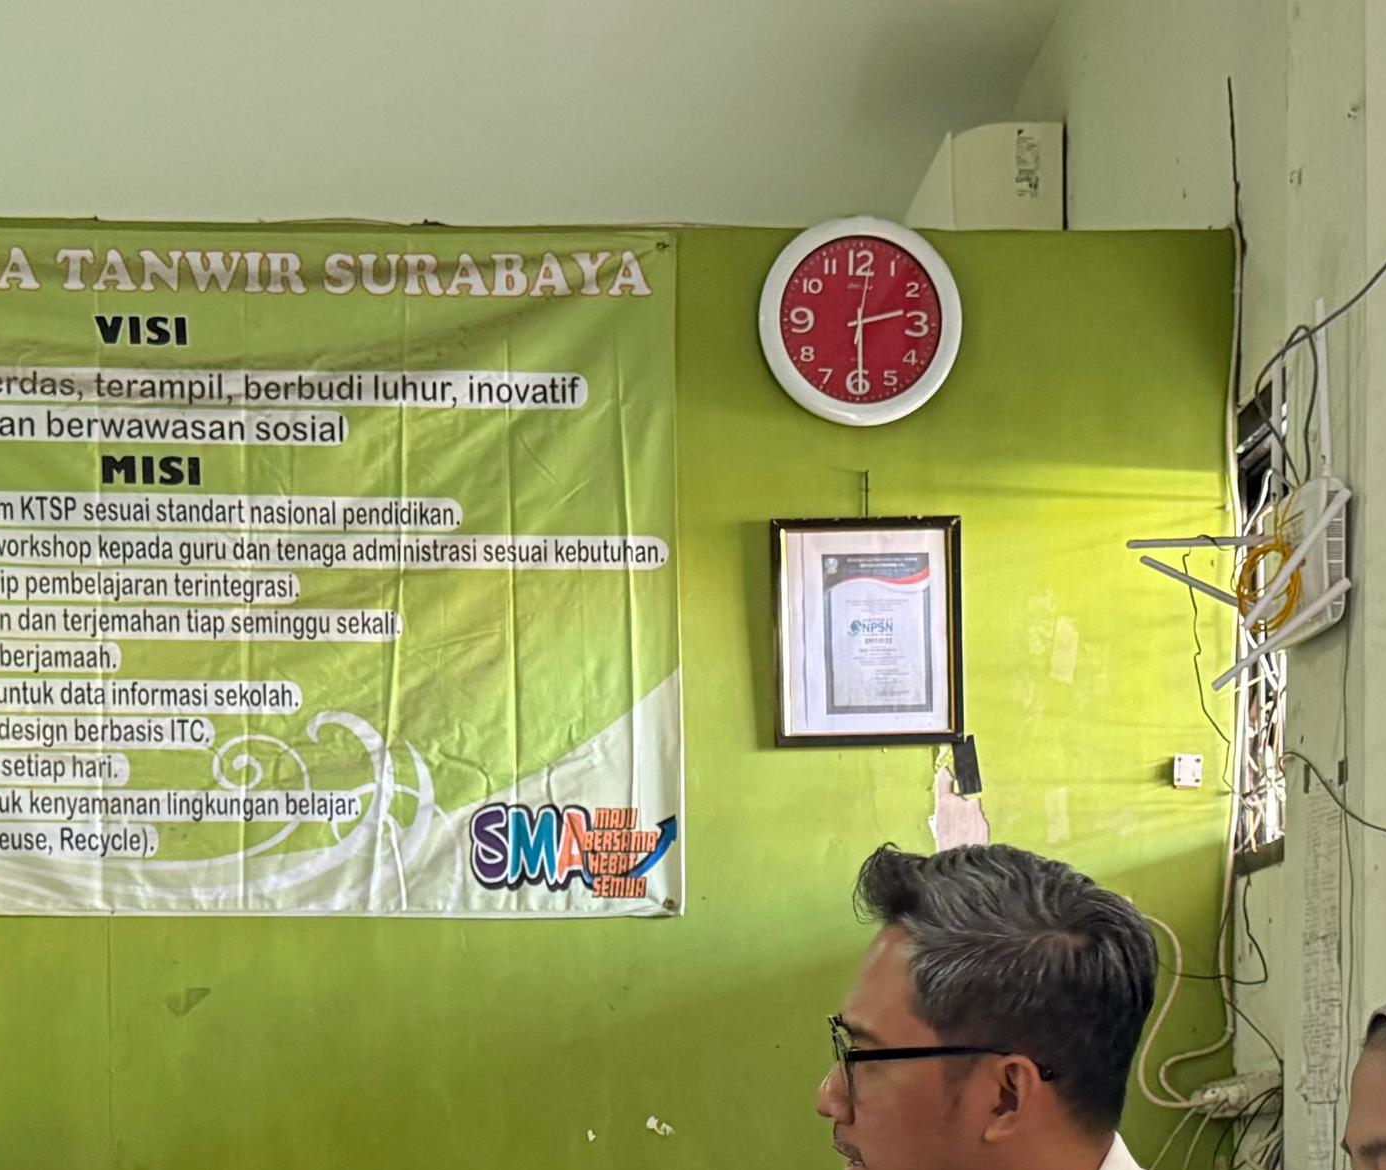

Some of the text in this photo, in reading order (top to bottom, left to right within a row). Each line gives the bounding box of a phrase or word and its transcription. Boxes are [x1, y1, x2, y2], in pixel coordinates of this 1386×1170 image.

[56, 248, 307, 296] TANWIR
[323, 251, 653, 299] SURABAYA
[823, 258, 837, 274] 11
[848, 250, 874, 276] 12
[890, 260, 895, 277] 1
[802, 278, 822, 294] 10
[905, 282, 919, 298] 2
[95, 315, 188, 346] VISI
[789, 307, 815, 334] 9
[904, 311, 930, 338] 3
[800, 346, 815, 362] 8
[902, 349, 918, 365] 4
[96, 373, 234, 404] terampil,
[244, 374, 363, 402] berbudi
[373, 375, 458, 407] luhur,
[468, 375, 581, 404] inovatif
[818, 368, 833, 385] 7
[845, 371, 870, 395] 6
[883, 370, 898, 386] 5
[46, 413, 245, 440] berwawasan
[255, 414, 348, 442] sosial
[101, 455, 201, 486] MISI
[20, 496, 77, 520] KTSP
[83, 499, 150, 521] sesuai
[156, 499, 246, 523] standart
[250, 501, 337, 525] nasional
[342, 502, 461, 529] pendidikan.
[98, 536, 173, 561] kepada
[179, 542, 227, 563] guru
[232, 538, 271, 560] dan
[276, 540, 347, 565] tenaga
[352, 539, 477, 562] administrasi
[483, 540, 548, 562] sesuai
[554, 539, 668, 563] kebutuhan.
[25, 572, 168, 600] pembelajaran
[174, 574, 300, 602] terintegrasi.
[17, 608, 57, 631] dan
[62, 609, 180, 636] terjemahan
[186, 608, 225, 638] tiap
[230, 611, 330, 639] seminggu
[336, 610, 400, 636] sekali.
[0, 644, 117, 670] berjamaah.
[60, 682, 106, 705] data
[112, 682, 208, 706] informasi
[214, 684, 302, 706] sekolah.
[74, 715, 164, 742] berbasis
[170, 716, 212, 742] ITC.
[1, 754, 66, 781] setiap
[72, 754, 118, 777] hari.
[29, 792, 161, 819] kenyamanan
[167, 792, 279, 822] lingkungan
[285, 793, 361, 820] belajar.
[595, 808, 638, 830] MAJU
[60, 827, 154, 856] Recycle).
[471, 804, 590, 888] SMA
[584, 831, 658, 852] BERSAMA
[592, 877, 647, 898] SEMUA
